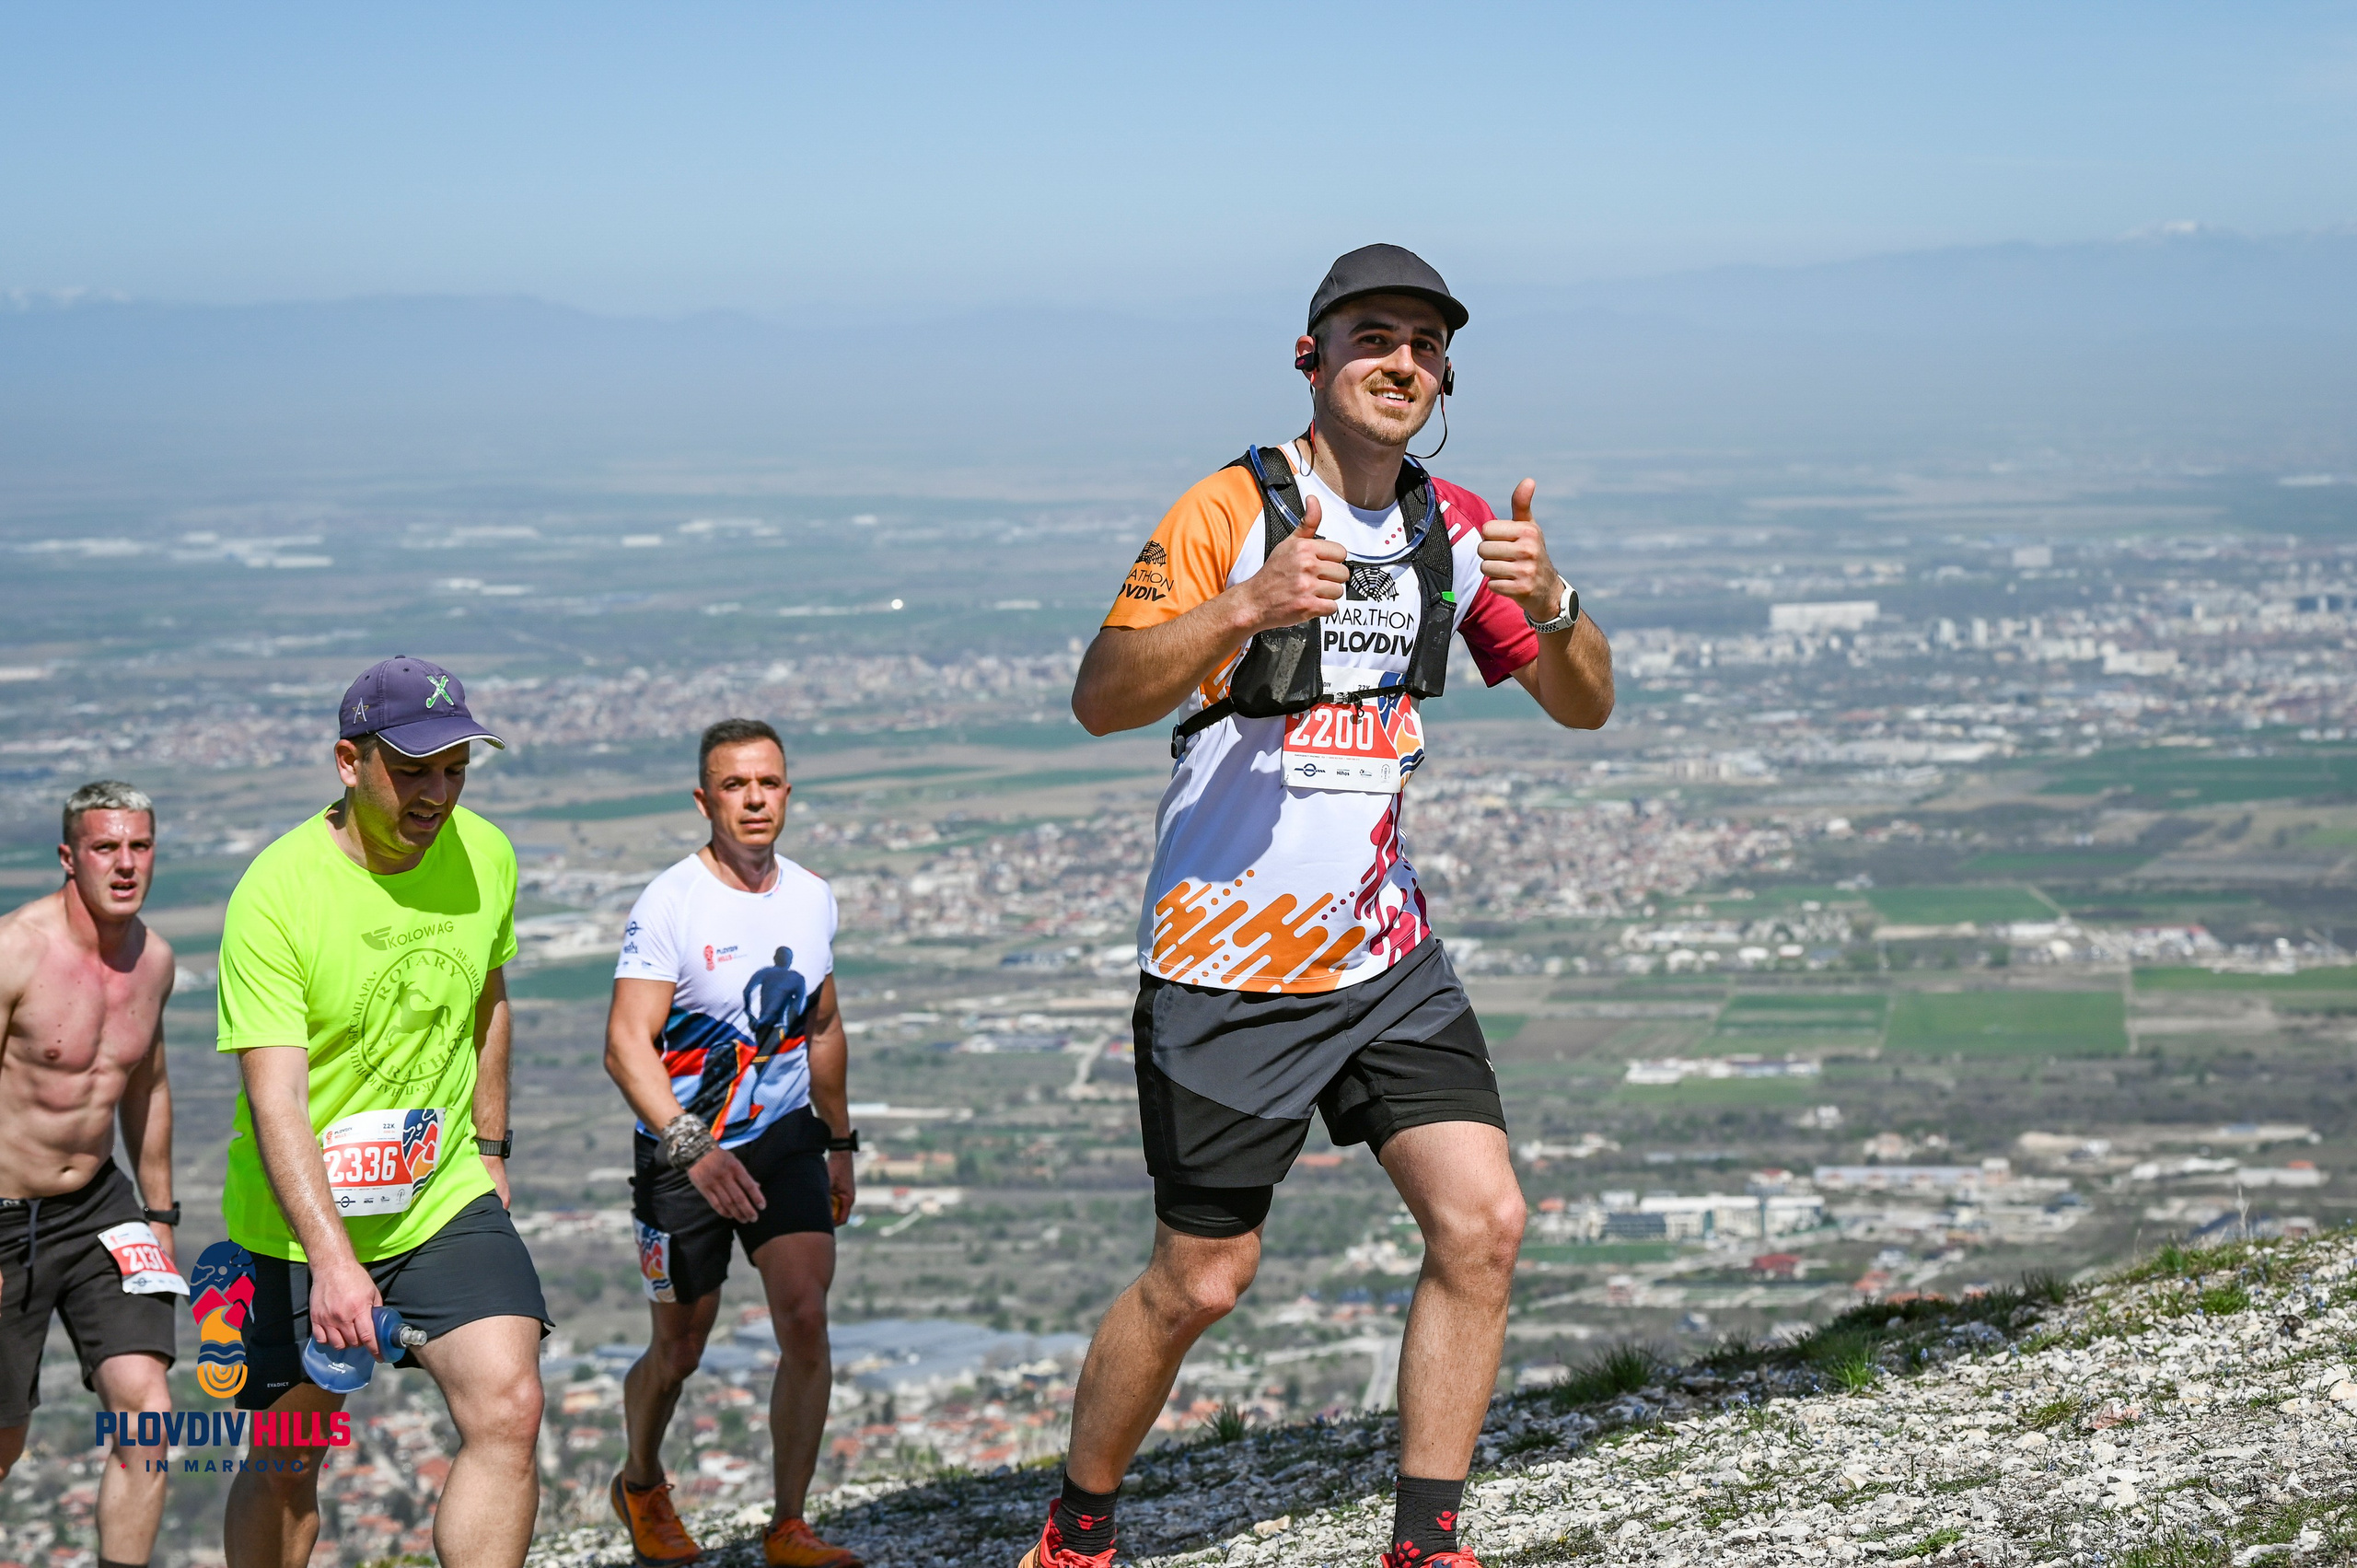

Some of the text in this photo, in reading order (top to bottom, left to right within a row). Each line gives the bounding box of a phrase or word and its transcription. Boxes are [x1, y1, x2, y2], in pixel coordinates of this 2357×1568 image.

[1127, 568, 1174, 592] ATHON
[1325, 608, 1415, 632] MARTHON
[1289, 708, 1375, 750] 2200
[388, 921, 454, 949] KOLOWAG
[377, 955, 462, 1001] ROTARY
[323, 1145, 399, 1184] 2336
[122, 1245, 168, 1272] 2131
